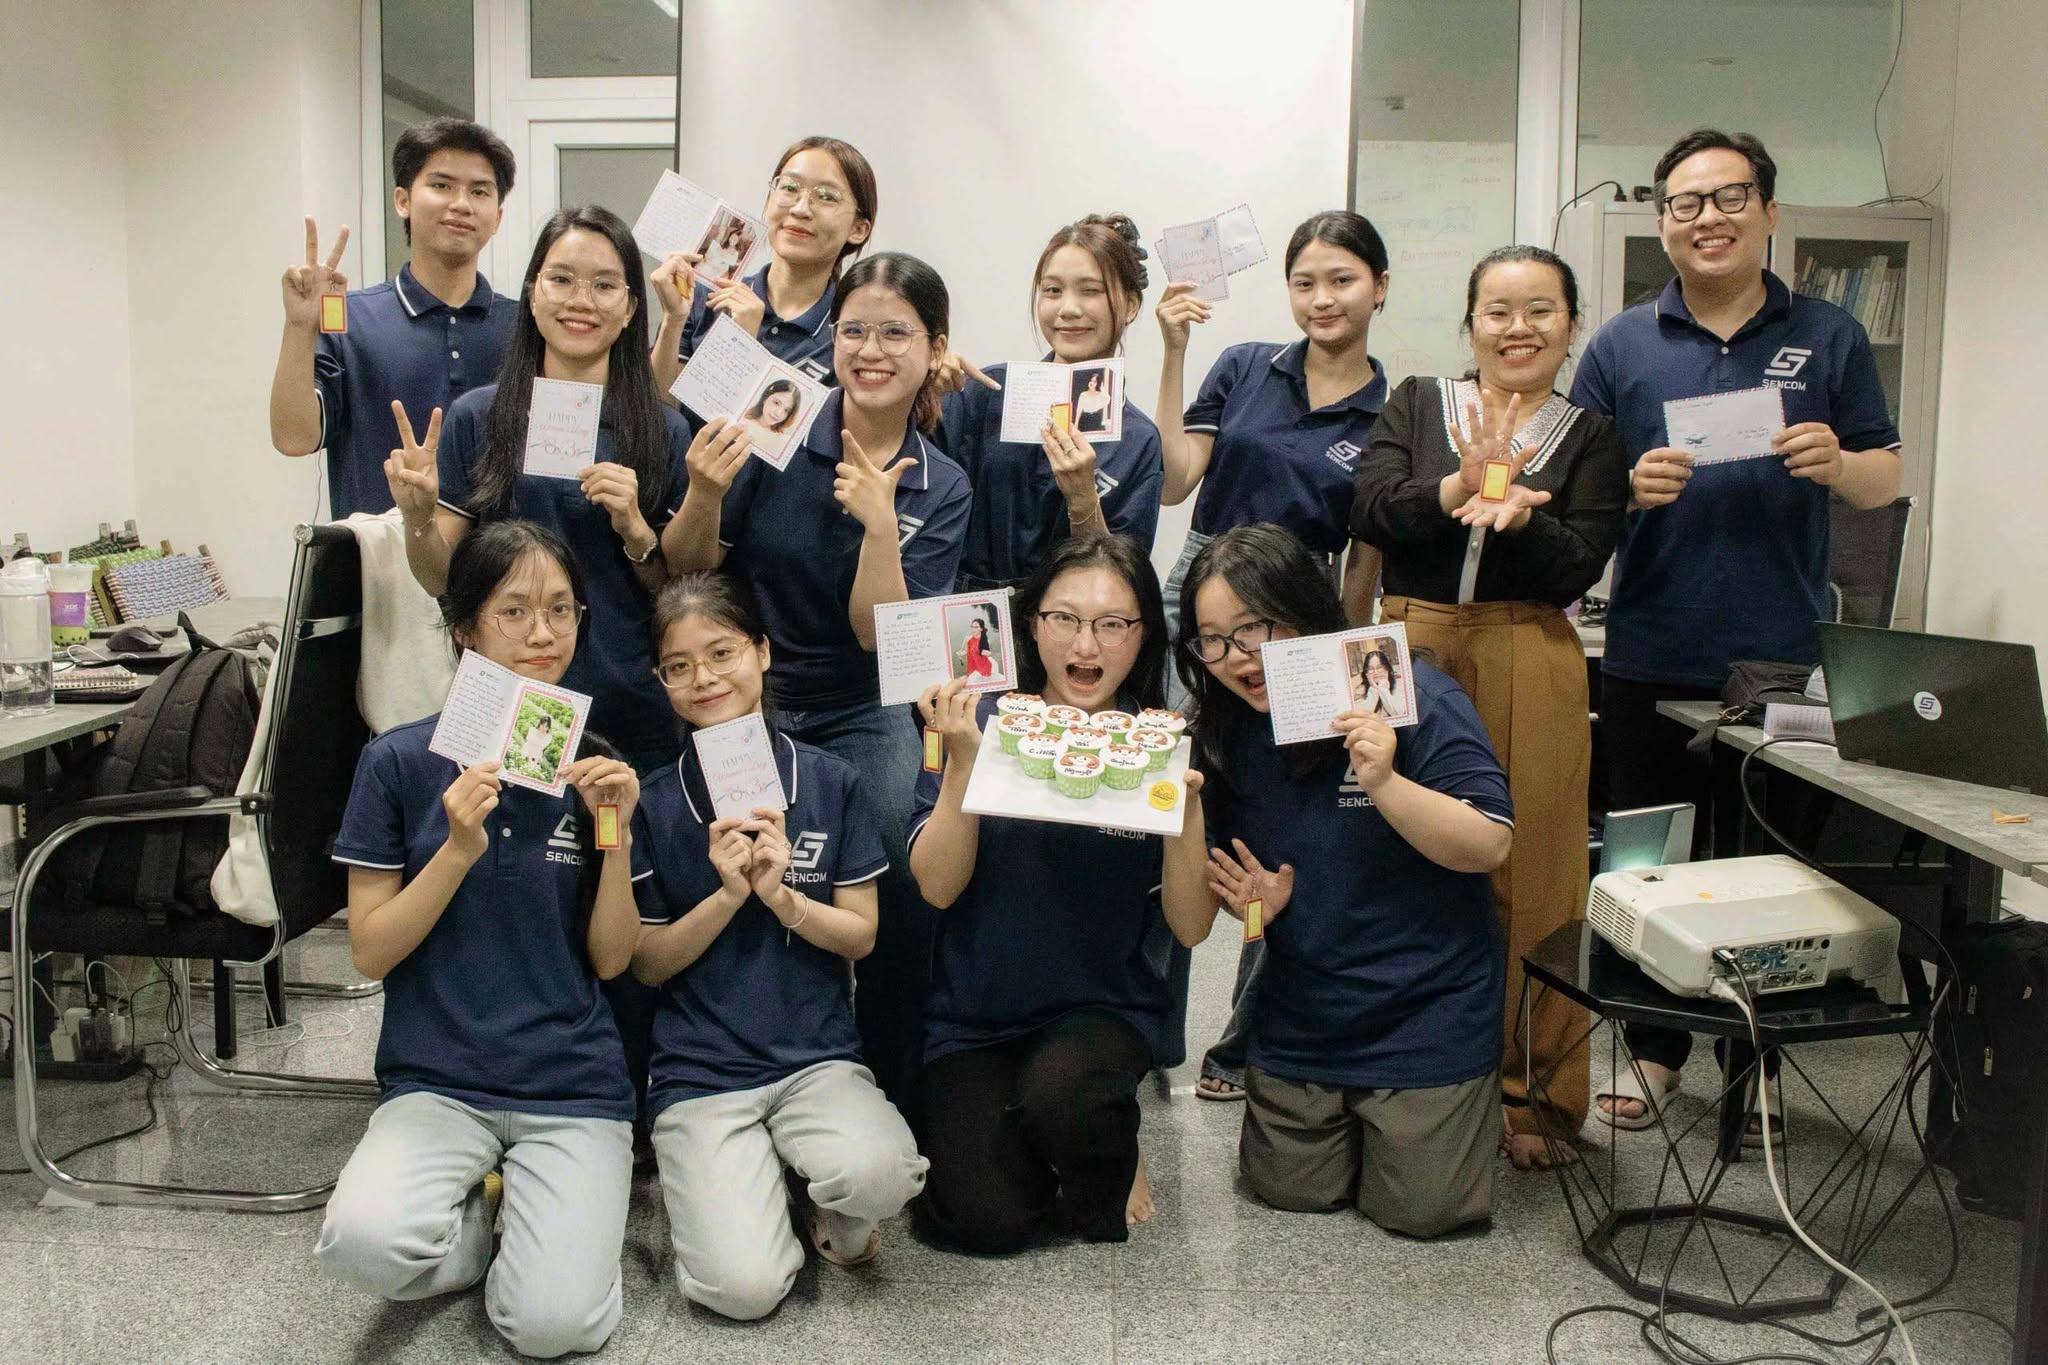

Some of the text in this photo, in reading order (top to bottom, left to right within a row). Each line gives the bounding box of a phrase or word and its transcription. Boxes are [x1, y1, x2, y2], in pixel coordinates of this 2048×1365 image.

[1762, 379, 1806, 391] SENCOM
[1325, 450, 1353, 472] SENCOM
[1098, 827, 1146, 841] SENCOM
[784, 871, 827, 883] SENCOM
